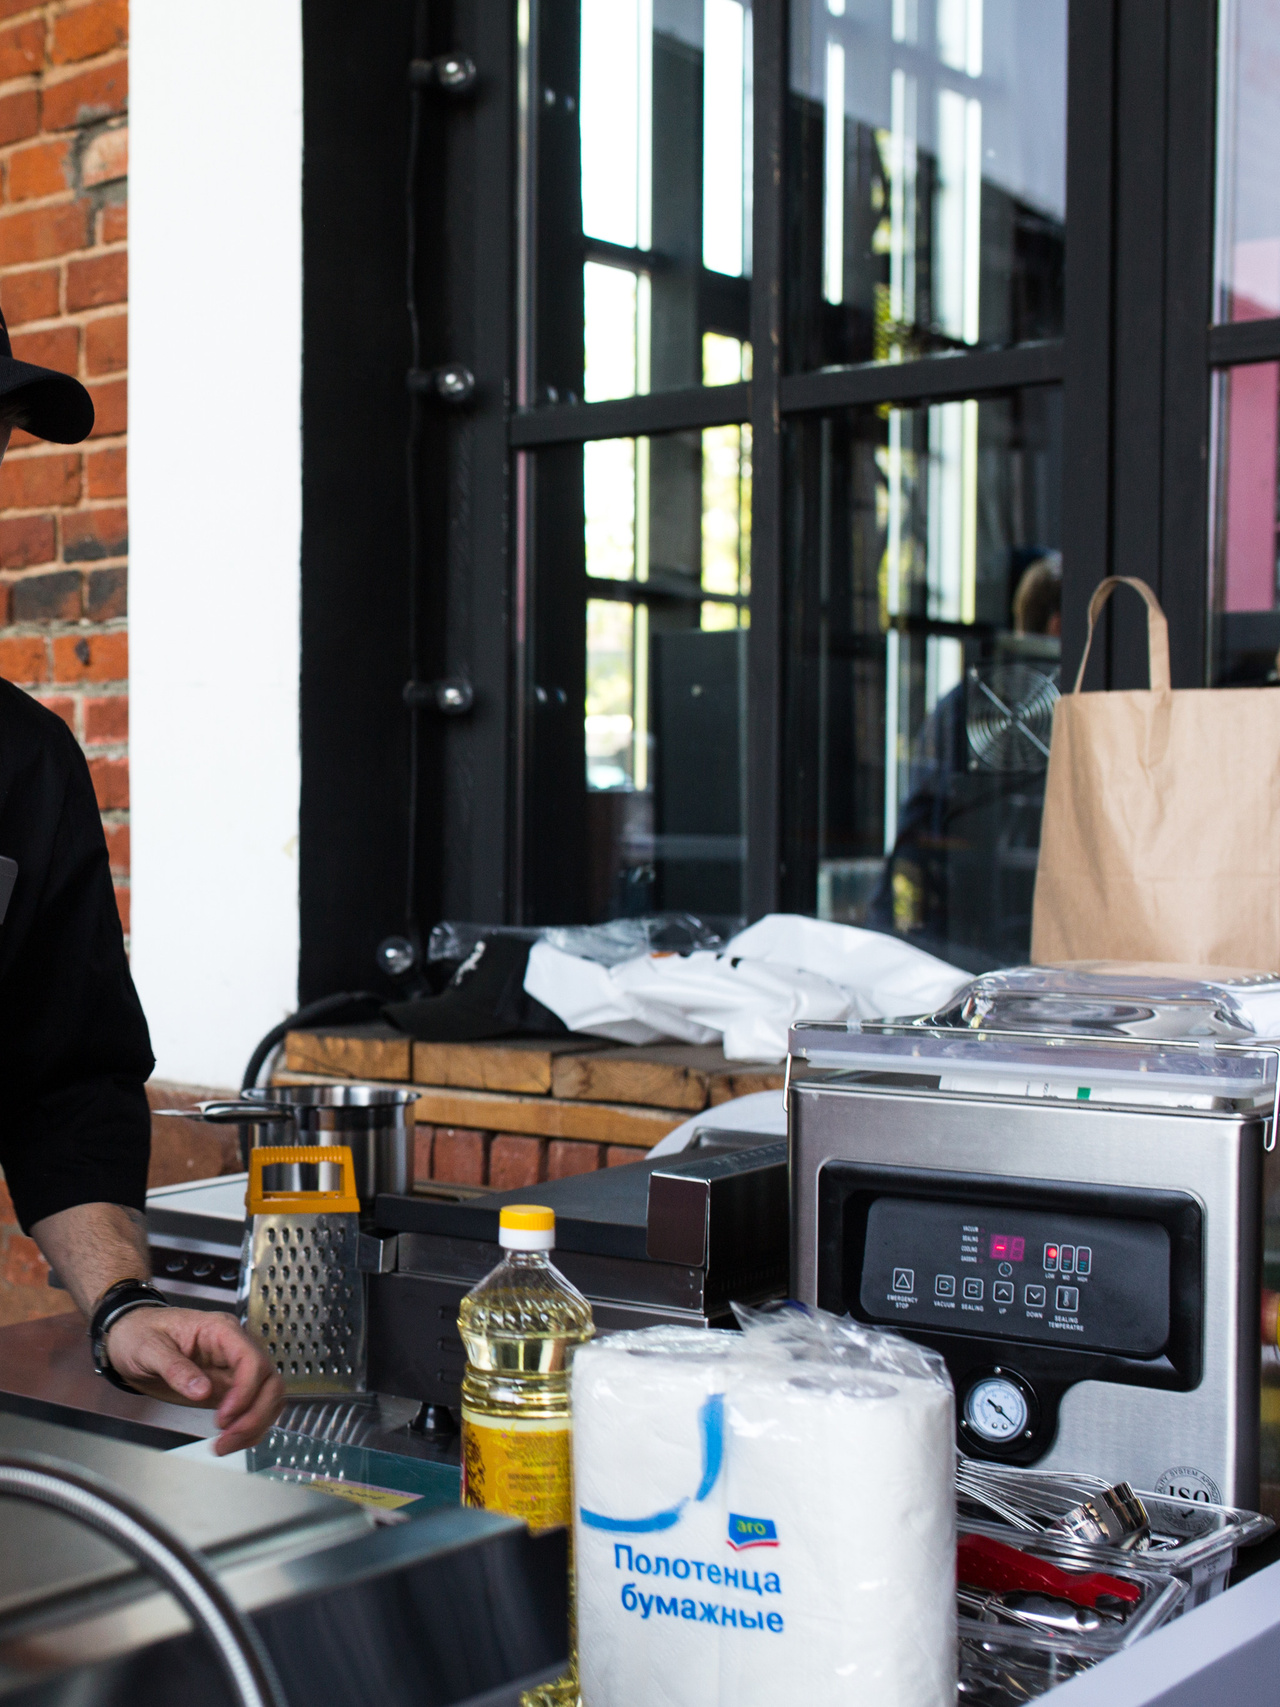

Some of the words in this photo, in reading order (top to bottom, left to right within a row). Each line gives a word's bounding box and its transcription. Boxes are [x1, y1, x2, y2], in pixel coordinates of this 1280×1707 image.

[886, 1294, 919, 1304] EMERGENCY
[895, 1302, 910, 1310] STOP
[933, 1300, 956, 1309] VACUUM
[960, 1303, 985, 1313] SEALING
[998, 1307, 1007, 1315] UP
[1026, 1310, 1043, 1319] DOWN
[1054, 1315, 1079, 1325] SEALING
[1168, 1485, 1210, 1503] ISO
[736, 1520, 767, 1536] aro
[613, 1542, 782, 1596] Полотенца
[621, 1582, 784, 1634] бумажные
